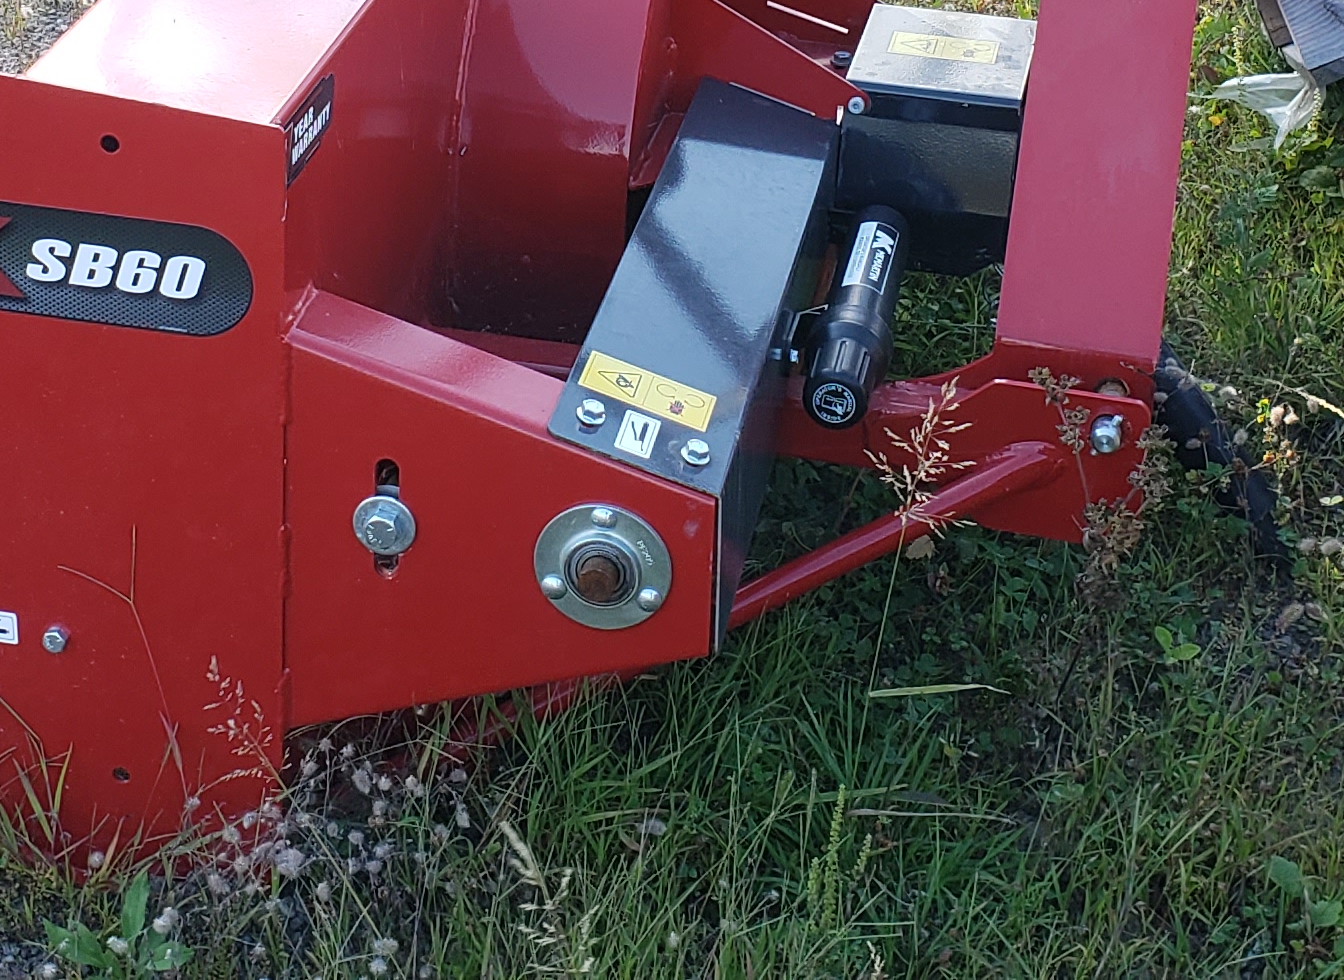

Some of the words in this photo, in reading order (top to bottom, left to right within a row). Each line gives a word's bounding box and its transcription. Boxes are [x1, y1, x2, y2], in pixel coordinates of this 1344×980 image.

[291, 100, 332, 166] WARRANTY
[293, 106, 315, 144] YEAR
[25, 238, 208, 300] SB60
